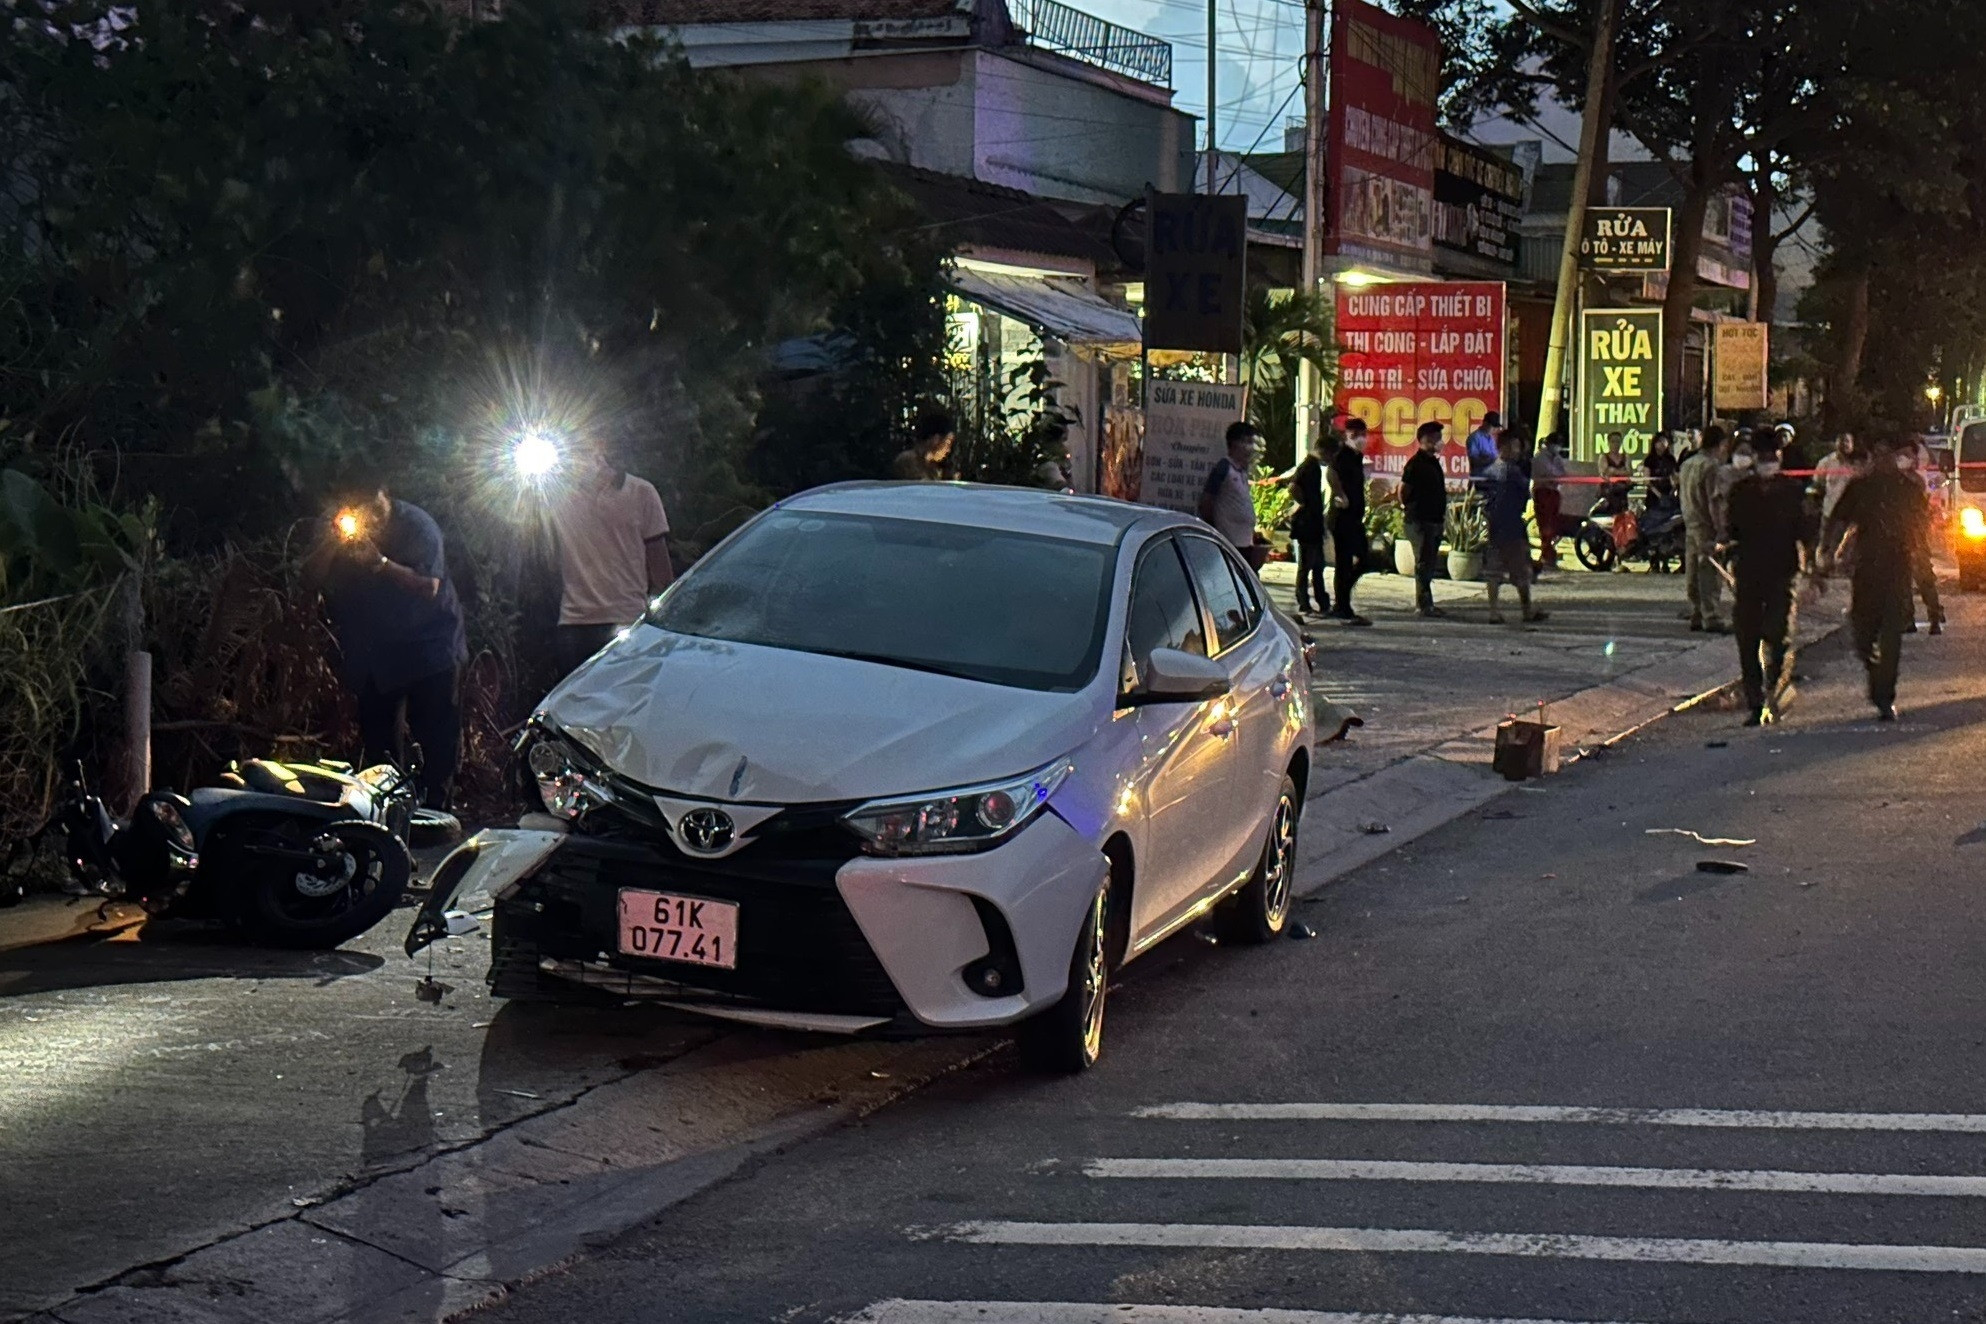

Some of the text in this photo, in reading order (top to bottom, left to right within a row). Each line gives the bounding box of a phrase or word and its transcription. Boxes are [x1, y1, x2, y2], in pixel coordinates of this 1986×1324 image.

[1597, 213, 1647, 236] RỬA
[1593, 238, 1608, 254] TÔ
[1619, 242, 1634, 254] XE
[1638, 238, 1663, 254] MÁY
[1349, 288, 1492, 322] CUNG CẤP THIẾT BỊ
[1346, 331, 1369, 353] THI
[1374, 328, 1416, 353] CÔNG
[1430, 324, 1460, 353] LẮP
[1464, 329, 1494, 358] ĐẶT
[1590, 318, 1652, 360] RỬA
[1344, 362, 1374, 389] BẢO
[1379, 364, 1402, 390] TRÌ
[1417, 362, 1449, 391] SỬA
[1453, 366, 1494, 391] CHỮA
[1602, 366, 1641, 397] XE
[1180, 388, 1195, 406] XE
[1198, 390, 1236, 410] HONDA
[1595, 403, 1650, 424] THAY
[1348, 397, 1489, 448] PCCC
[1595, 428, 1653, 454] NỚT
[654, 897, 705, 929] 61K
[631, 925, 721, 962] 077.41
